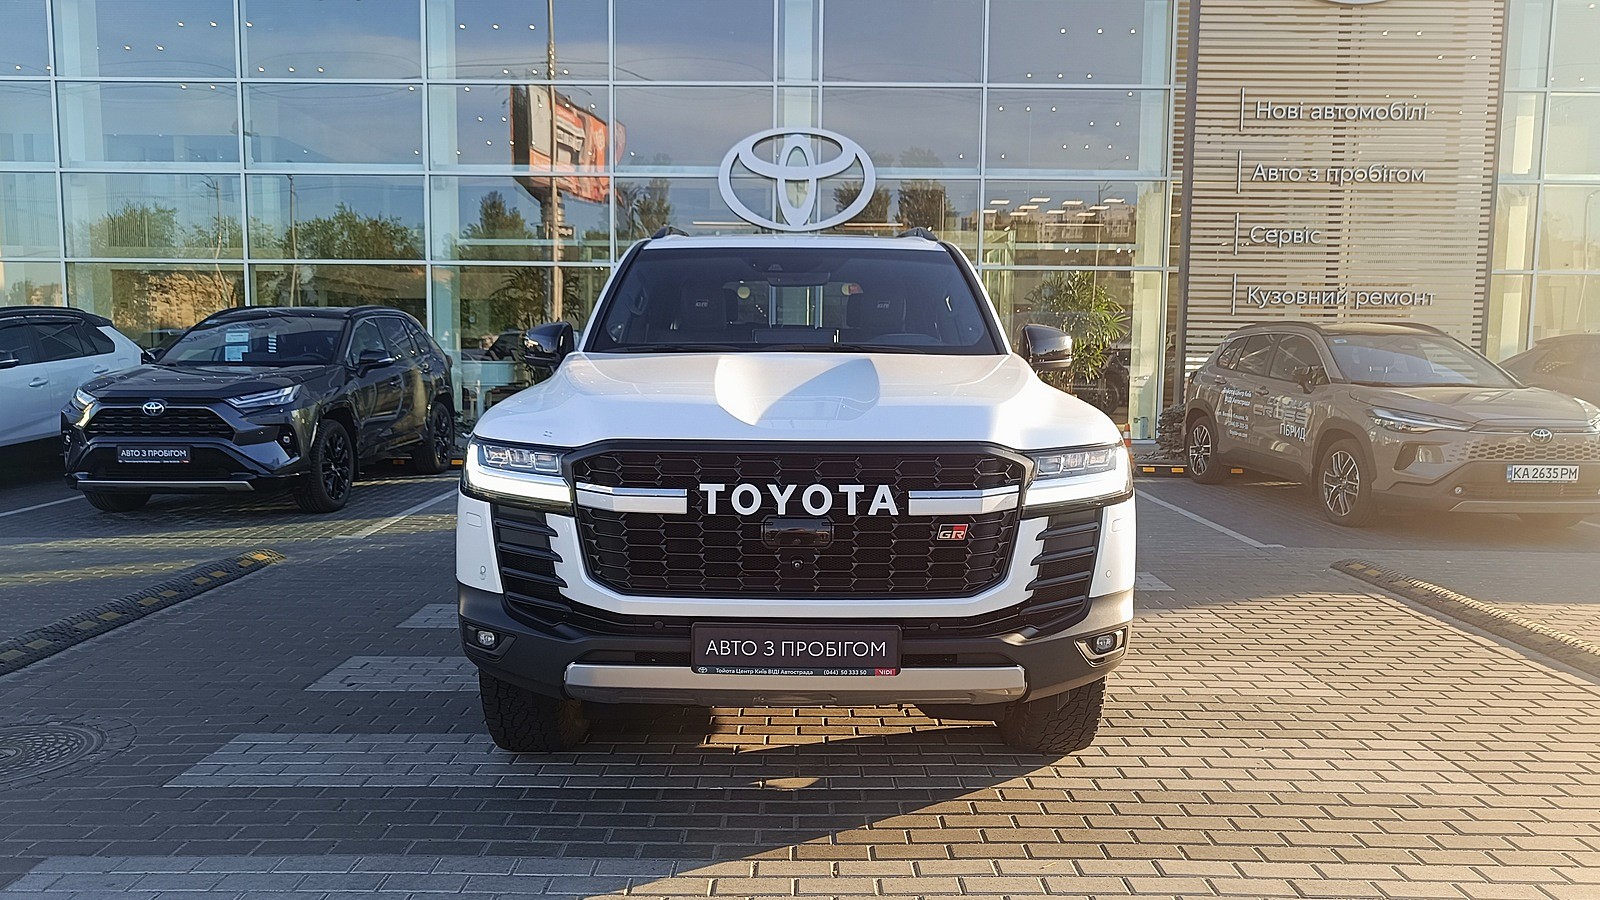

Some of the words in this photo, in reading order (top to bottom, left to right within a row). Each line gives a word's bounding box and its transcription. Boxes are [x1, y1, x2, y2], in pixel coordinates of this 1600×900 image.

[1255, 101, 1303, 120] Нові
[1310, 101, 1429, 120] автомобілі
[1251, 163, 1302, 182] Авто
[1308, 167, 1319, 182] з
[1326, 163, 1427, 187] пробігом
[1249, 226, 1322, 248] Сервіс
[1247, 286, 1349, 309] Кузовний
[1355, 289, 1437, 310] ремонт
[120, 449, 141, 457] АВТО
[147, 449, 187, 457] ПРОБІГОМ
[699, 483, 899, 516] TOYOTA
[938, 529, 966, 540] GR
[705, 640, 757, 656] АВТО
[763, 640, 775, 656] З
[781, 640, 887, 657] ПРОБІГОМ
[823, 668, 839, 676] (044)
